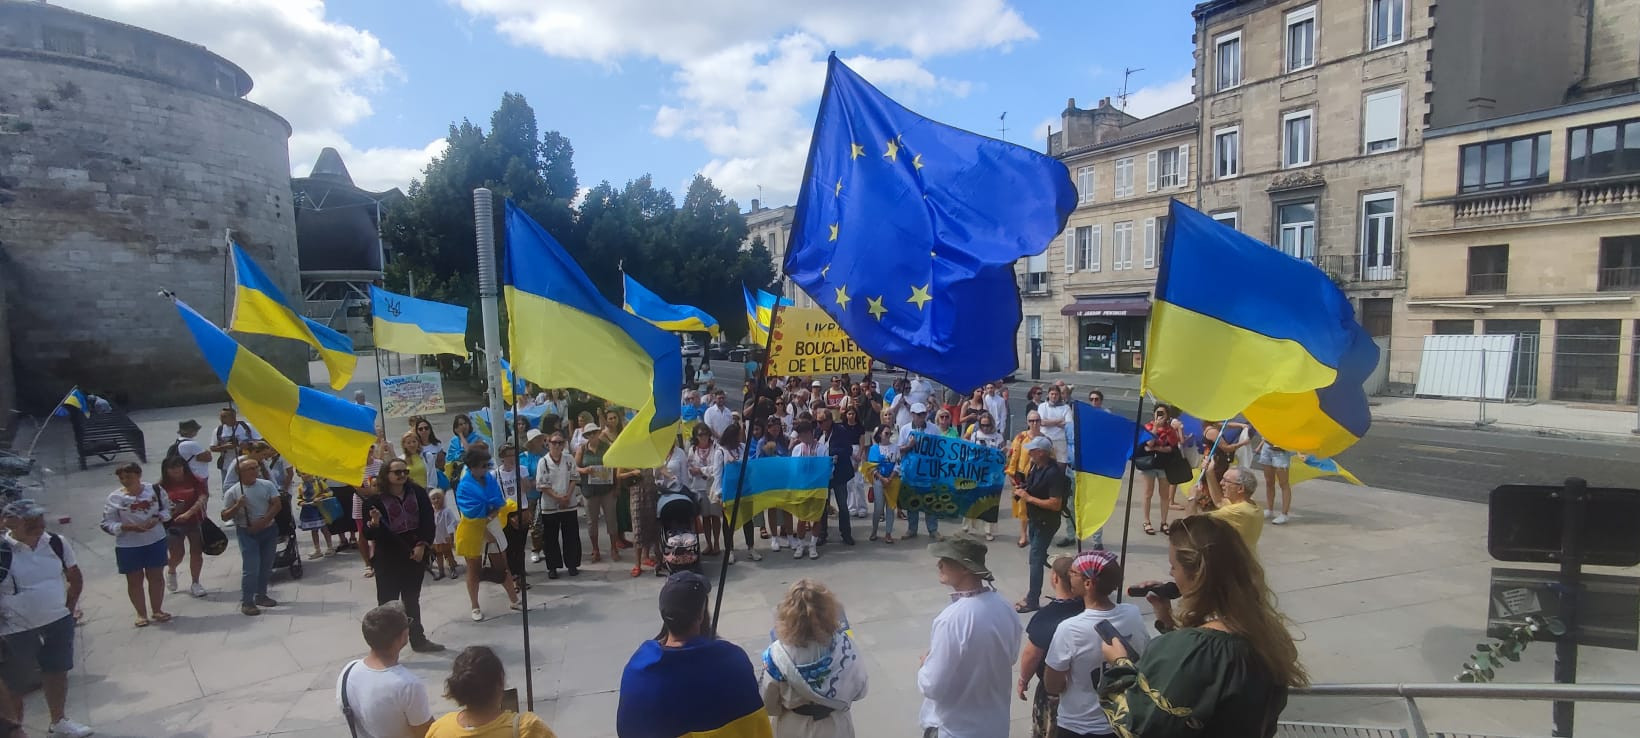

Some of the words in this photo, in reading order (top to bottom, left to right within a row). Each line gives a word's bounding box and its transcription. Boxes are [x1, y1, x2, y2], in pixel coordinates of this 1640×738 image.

[788, 359, 806, 373] DE
[813, 356, 867, 372] L'EUROPE
[913, 435, 947, 458] NOUS
[948, 442, 1005, 465] SOMMES
[916, 457, 990, 483] L'UKRAINE
